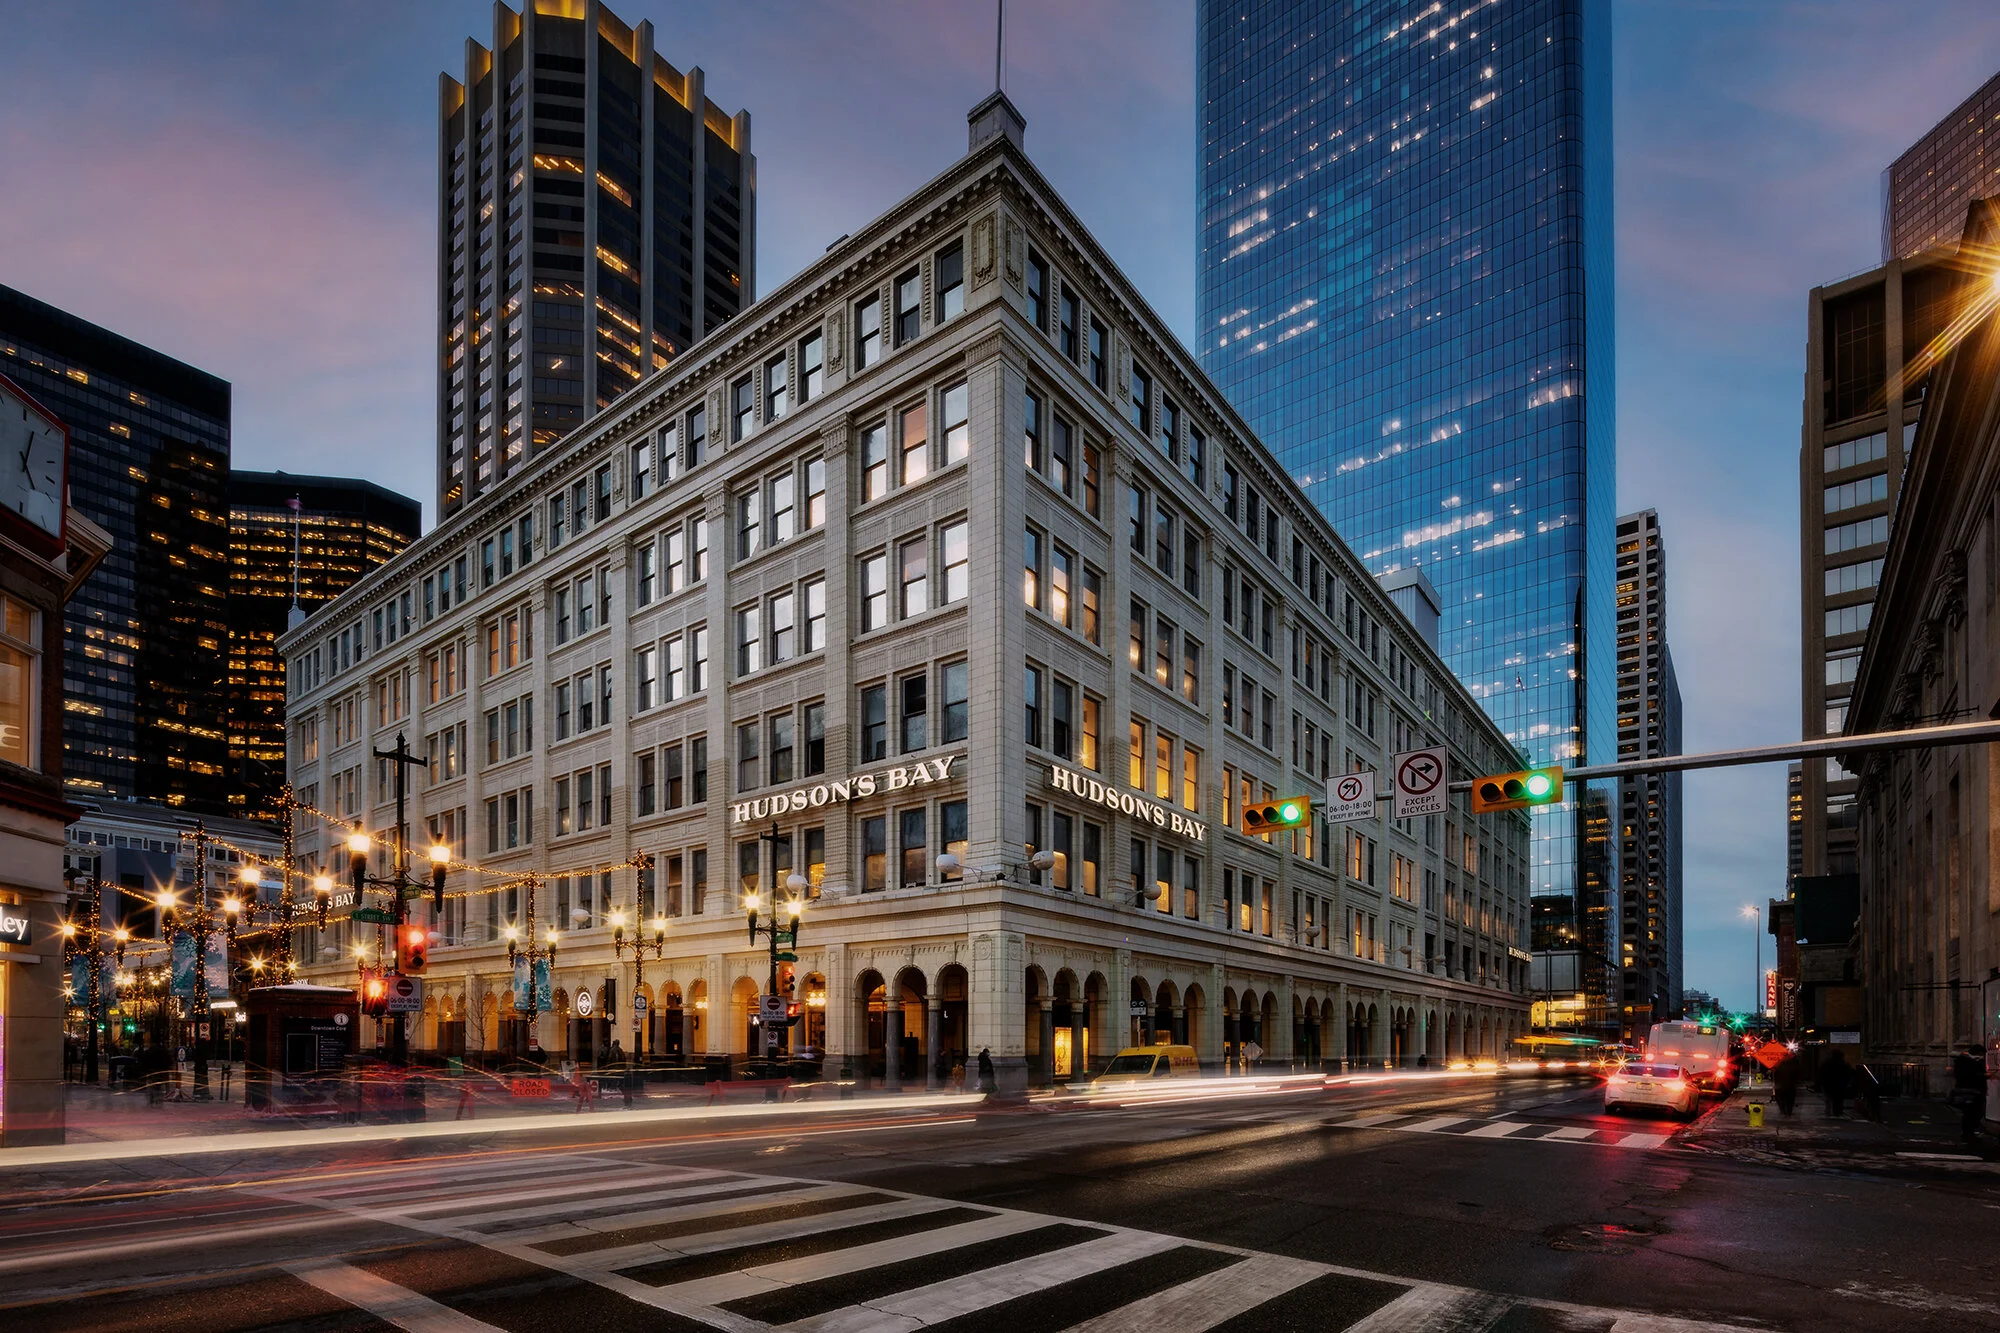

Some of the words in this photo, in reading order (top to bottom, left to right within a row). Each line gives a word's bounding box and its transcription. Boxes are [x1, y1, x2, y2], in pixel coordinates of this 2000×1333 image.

[733, 774, 877, 823] HUDSON'S
[887, 755, 956, 791] BAY
[1051, 764, 1166, 827] HUDSON'S
[1170, 813, 1206, 842] BAY
[1405, 795, 1436, 806] EXCEPT
[1401, 803, 1441, 815] BICYCLES
[335, 892, 355, 909] BAY
[519, 1080, 543, 1088] ROAD
[514, 1088, 548, 1096] CLOSED
